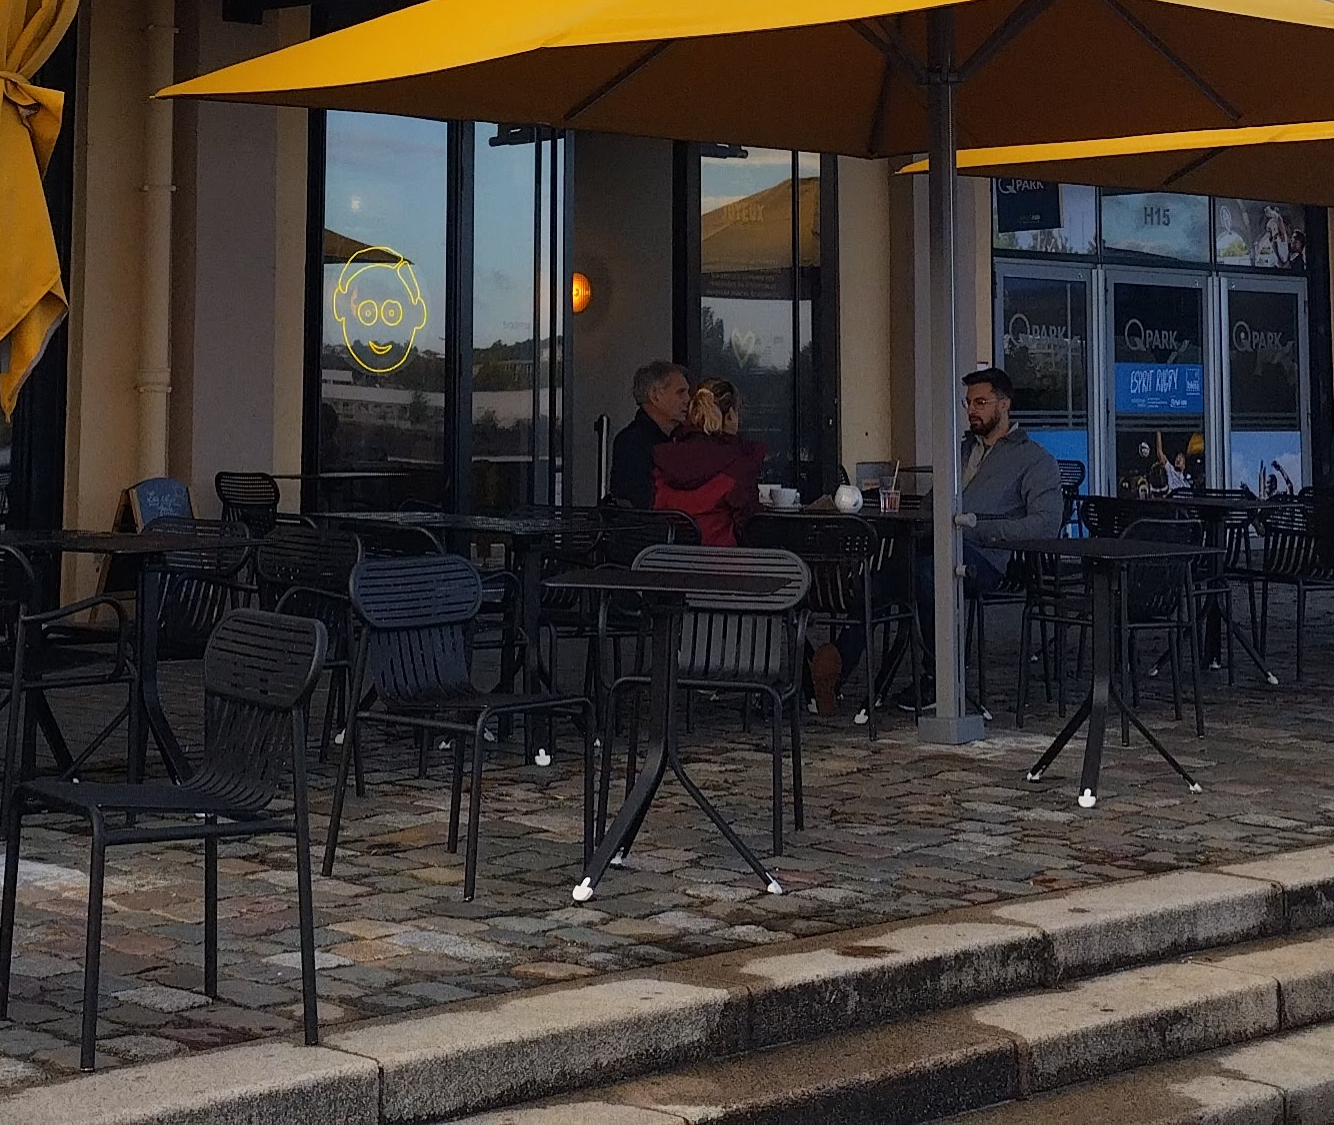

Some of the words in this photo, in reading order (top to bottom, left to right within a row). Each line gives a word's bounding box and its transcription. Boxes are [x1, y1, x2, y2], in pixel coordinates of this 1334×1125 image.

[1143, 206, 1171, 227] H15
[1130, 369, 1155, 394] ESPRIT
[1155, 367, 1179, 393] RUGBY
